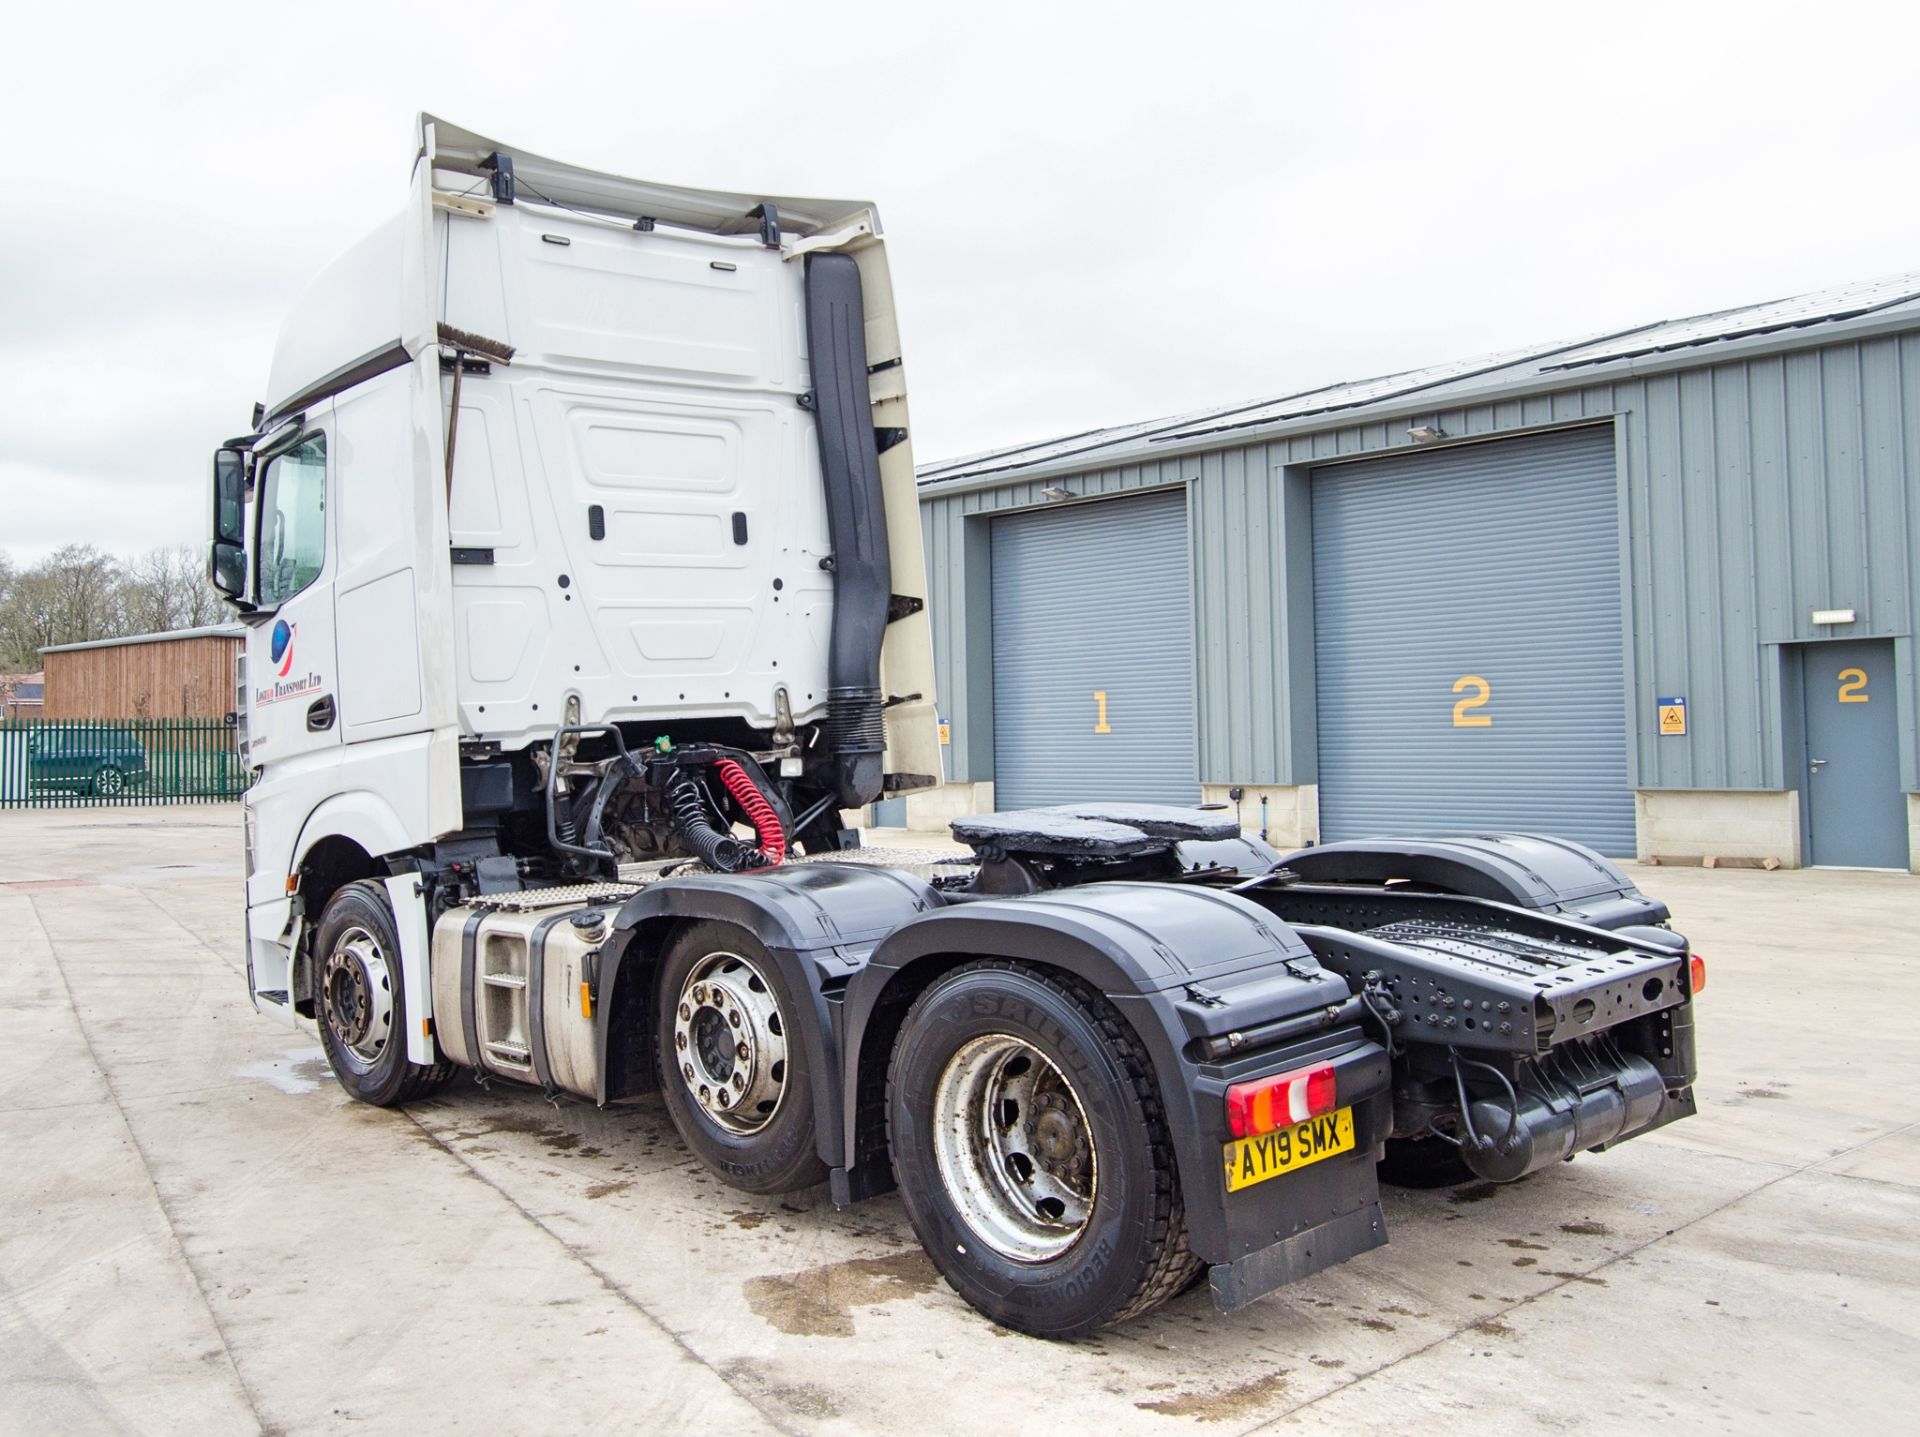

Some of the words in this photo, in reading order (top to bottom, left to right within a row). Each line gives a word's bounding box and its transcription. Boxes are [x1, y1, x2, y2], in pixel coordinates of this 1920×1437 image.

[1452, 675, 1493, 728] 2
[1838, 668, 1869, 703] 2
[1093, 691, 1112, 734] 1
[1242, 1131, 1292, 1180] AY19
[1299, 1114, 1341, 1159] SMX
